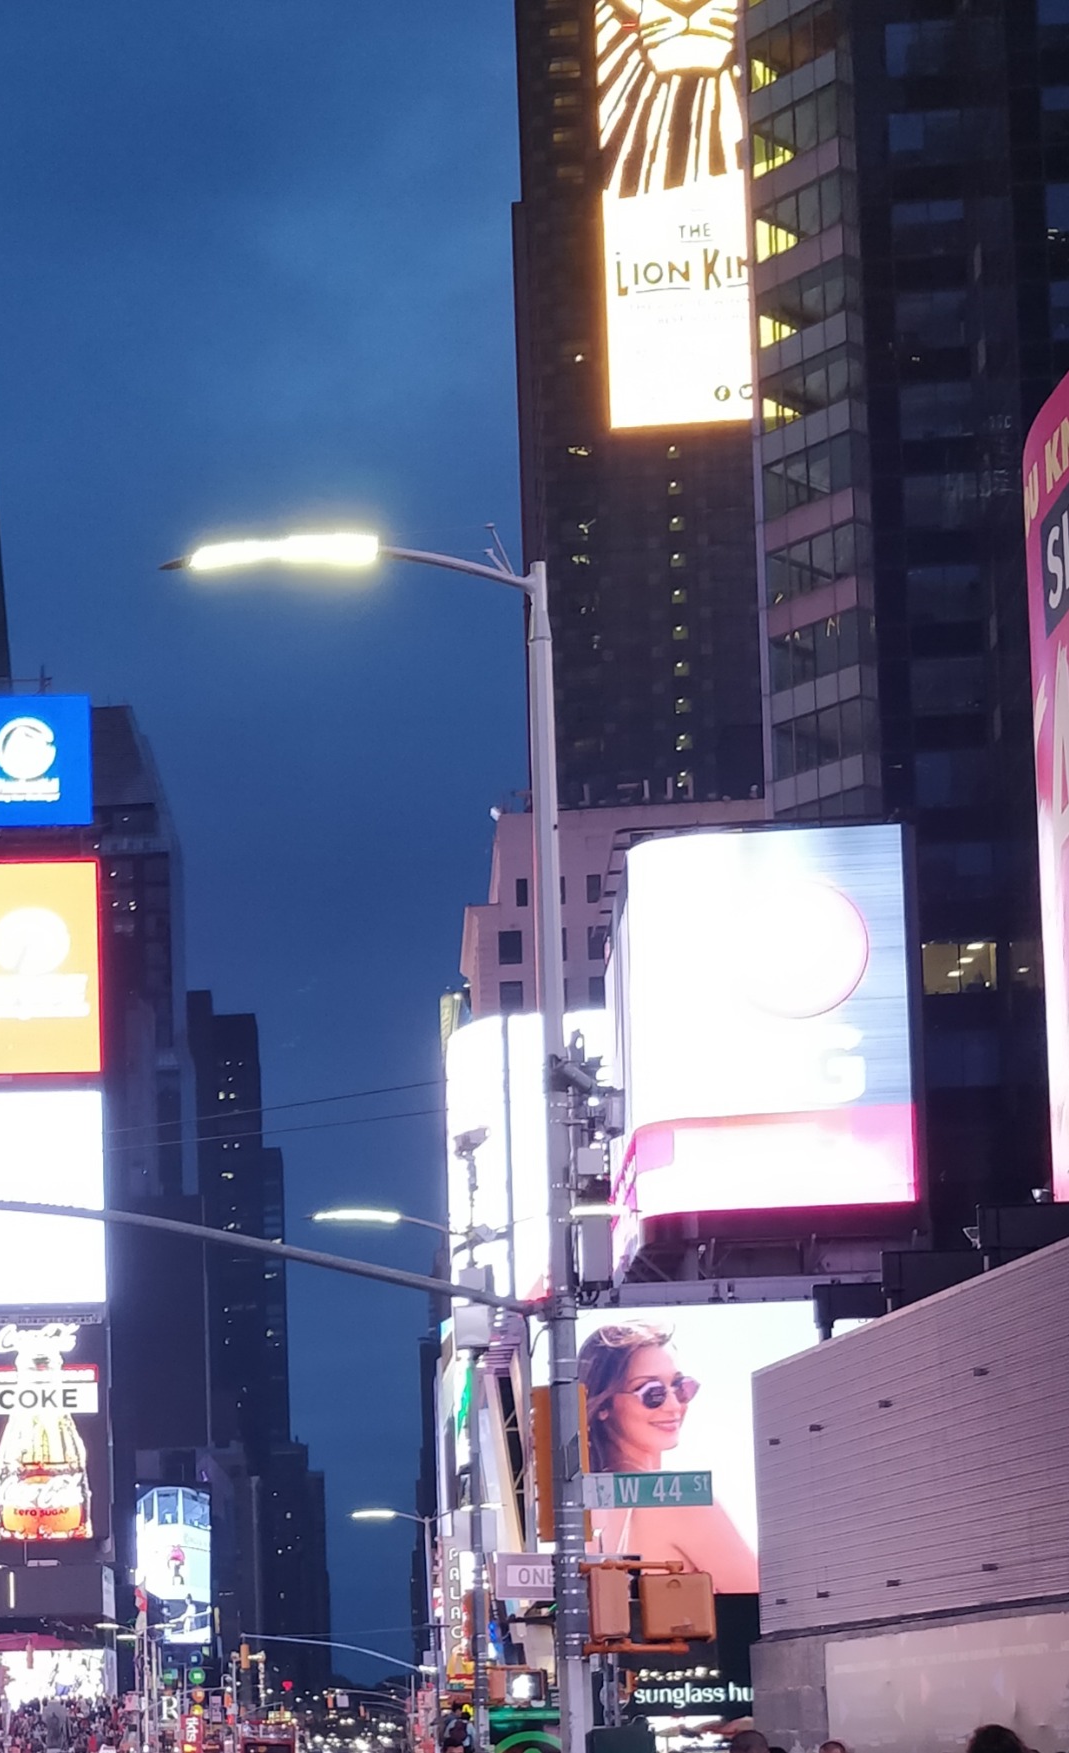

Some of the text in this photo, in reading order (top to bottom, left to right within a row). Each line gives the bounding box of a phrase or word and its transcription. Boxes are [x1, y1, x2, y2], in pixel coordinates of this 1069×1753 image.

[678, 223, 711, 238] THE
[616, 260, 690, 296] LION
[1047, 508, 1069, 610] S
[618, 1475, 709, 1503] W 44 St
[448, 1548, 465, 1652] PALAC
[633, 1682, 726, 1709] sunglass
